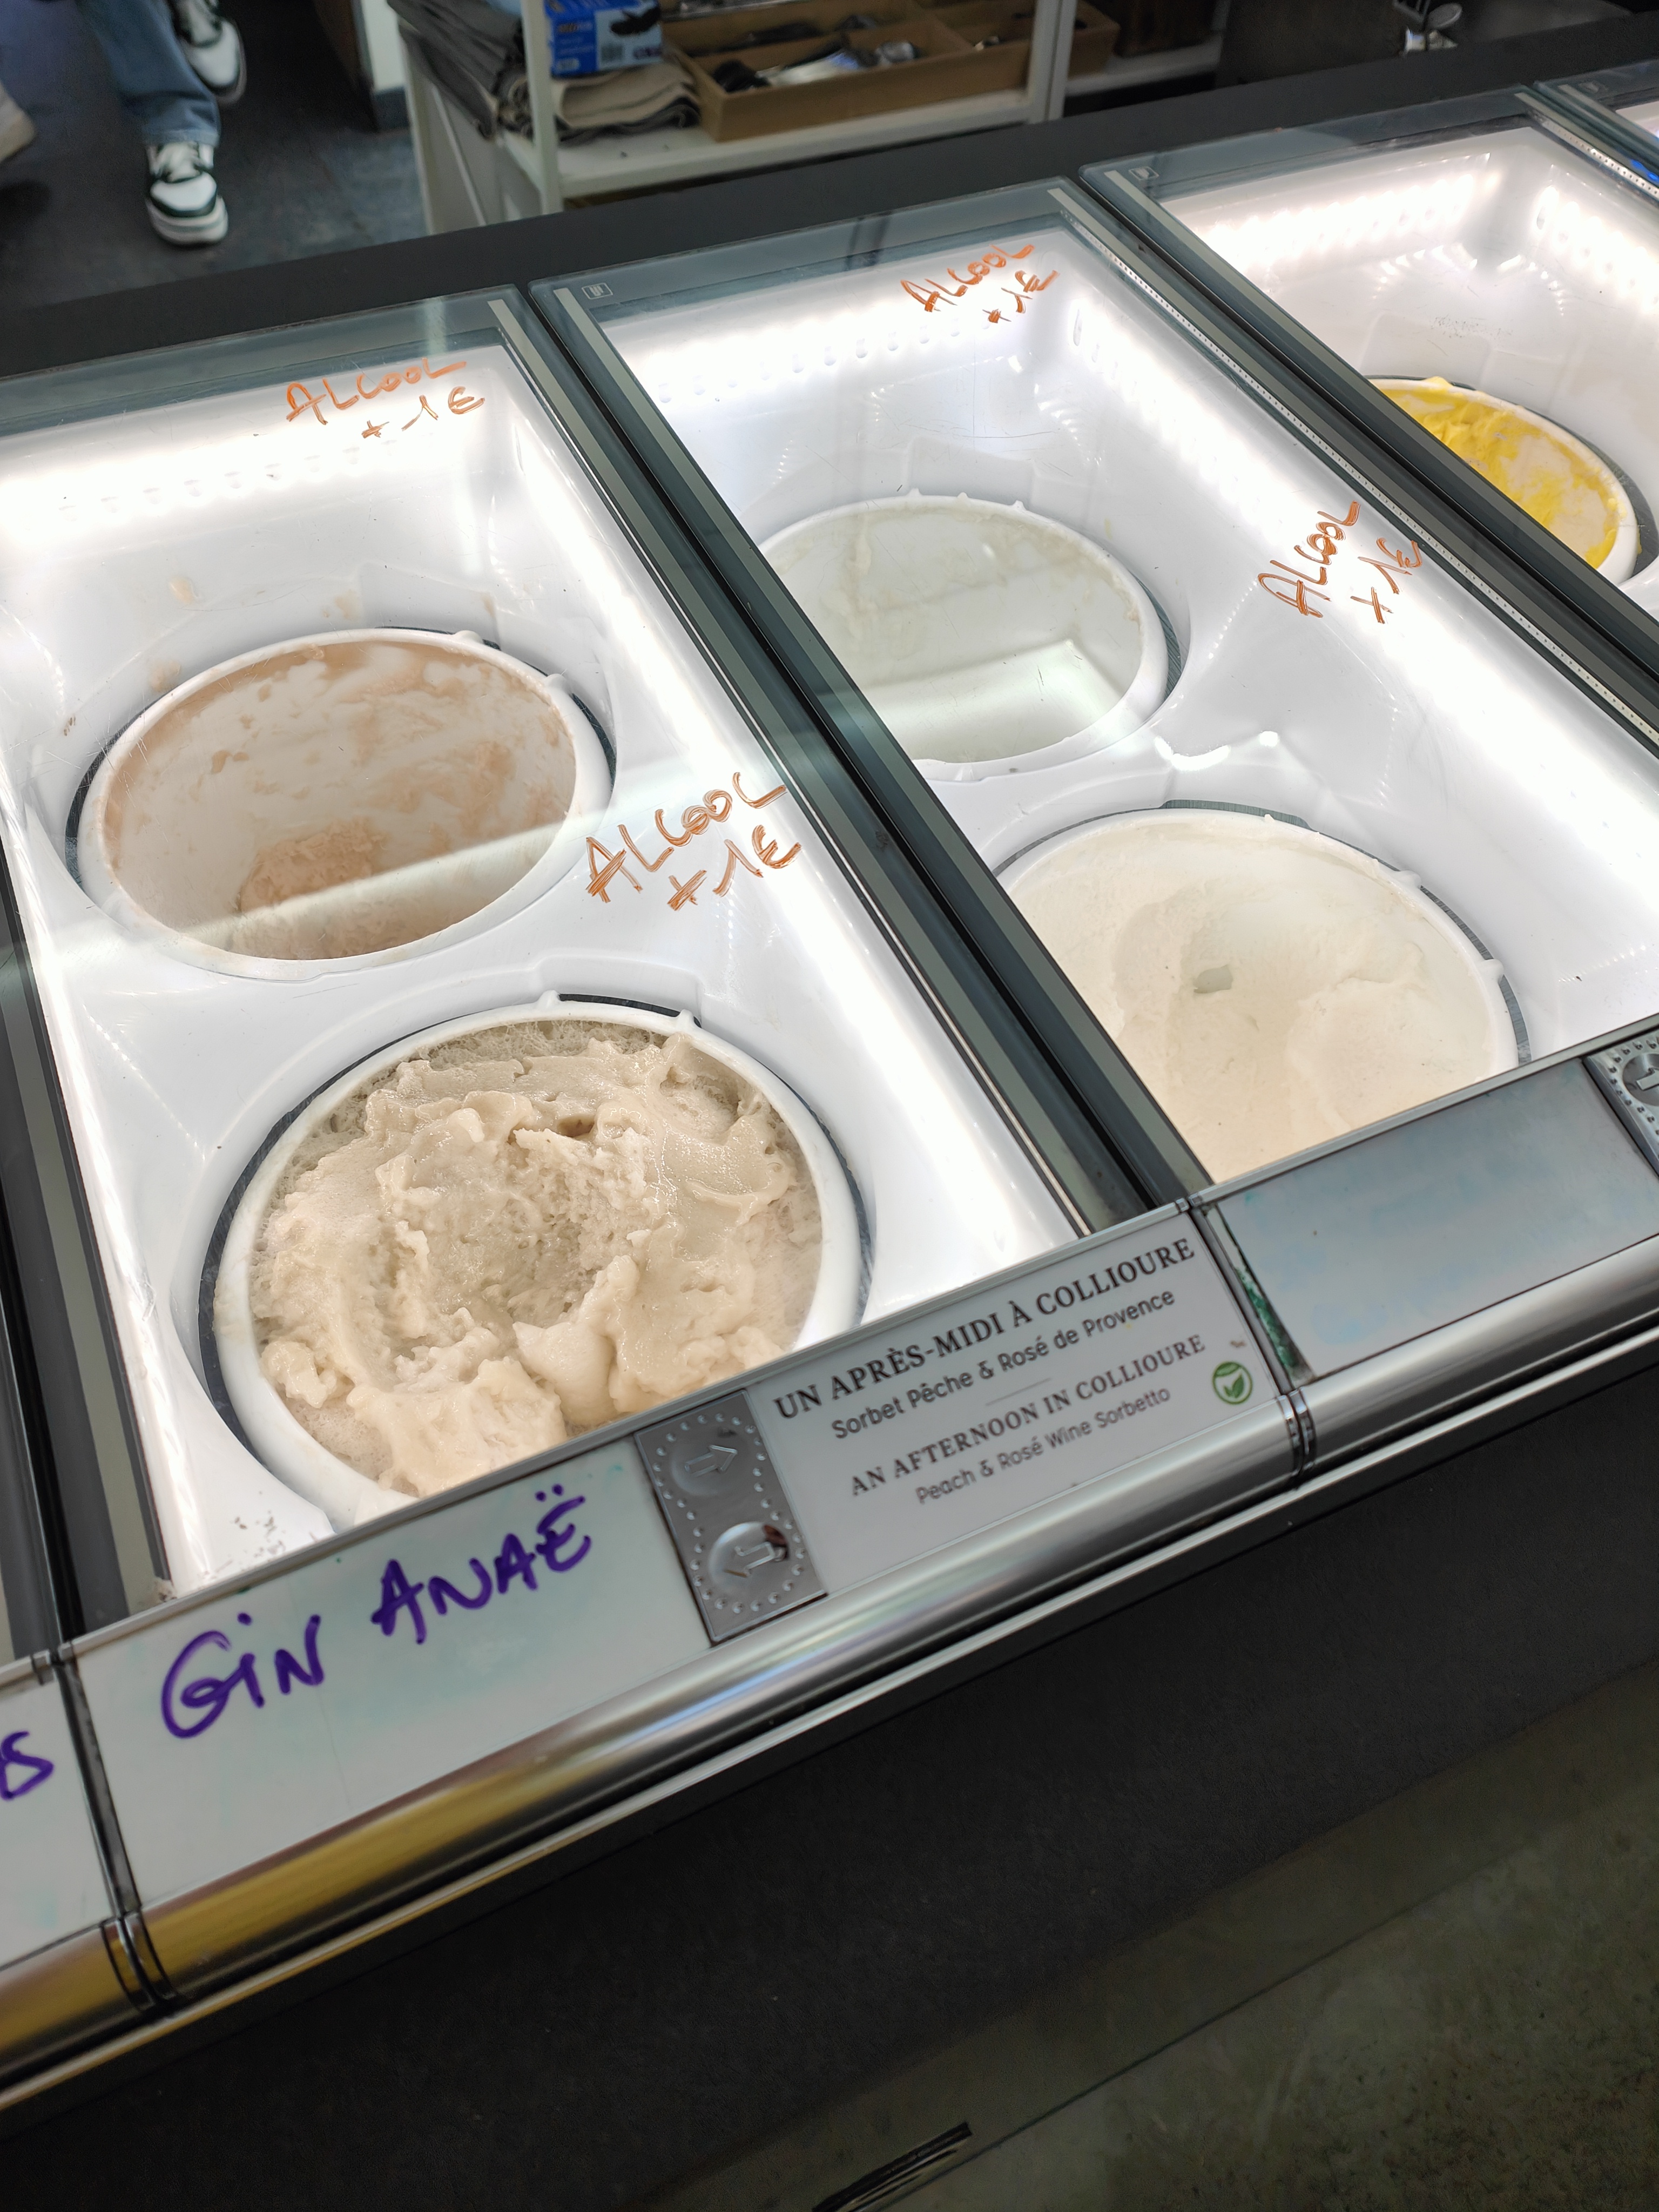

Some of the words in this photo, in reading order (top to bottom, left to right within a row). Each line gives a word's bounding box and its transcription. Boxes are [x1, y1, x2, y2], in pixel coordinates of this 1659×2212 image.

[901, 245, 1035, 312] ALCOOL
[286, 358, 467, 425] ALCOOL
[1258, 501, 1360, 617] ALCOOL
[586, 772, 787, 903] ALCOOL
[773, 1384, 822, 1419] UN
[831, 1312, 1005, 1400] APRÈS-MIDI
[1008, 1300, 1033, 1327] À
[1036, 1238, 1195, 1316] COLLIOURE
[832, 1397, 905, 1439] Sorbet
[978, 1360, 995, 1379] &
[997, 1335, 1049, 1372] Rosé
[1053, 1329, 1080, 1350] de
[1082, 1291, 1176, 1337] Provence
[852, 1466, 886, 1496] AN
[894, 1402, 1040, 1479] AFTERNOON
[1042, 1389, 1071, 1414] IN
[1076, 1334, 1206, 1400] COLLIOURE
[915, 1468, 976, 1504] Peach
[980, 1459, 994, 1477] &
[996, 1435, 1044, 1469] Rosé
[1044, 1420, 1092, 1449] Wine
[1094, 1387, 1171, 1428] Sorbetto
[372, 1484, 591, 1643] ANAË
